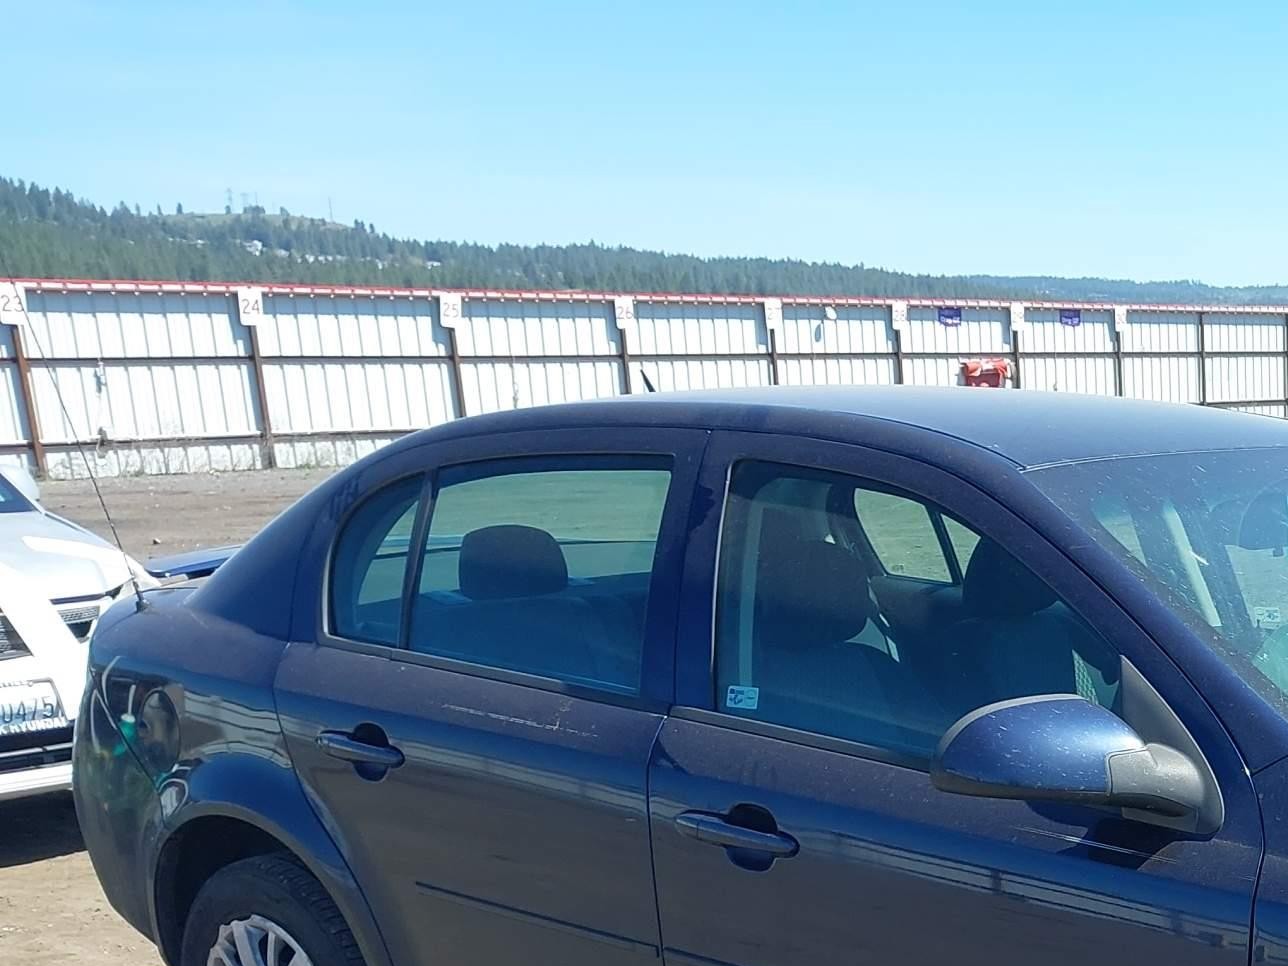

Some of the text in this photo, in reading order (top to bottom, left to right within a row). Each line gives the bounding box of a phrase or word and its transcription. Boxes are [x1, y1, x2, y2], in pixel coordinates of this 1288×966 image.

[1, 294, 23, 312] 23
[242, 298, 260, 315] 24
[443, 302, 459, 318] 25
[617, 305, 634, 320] 26
